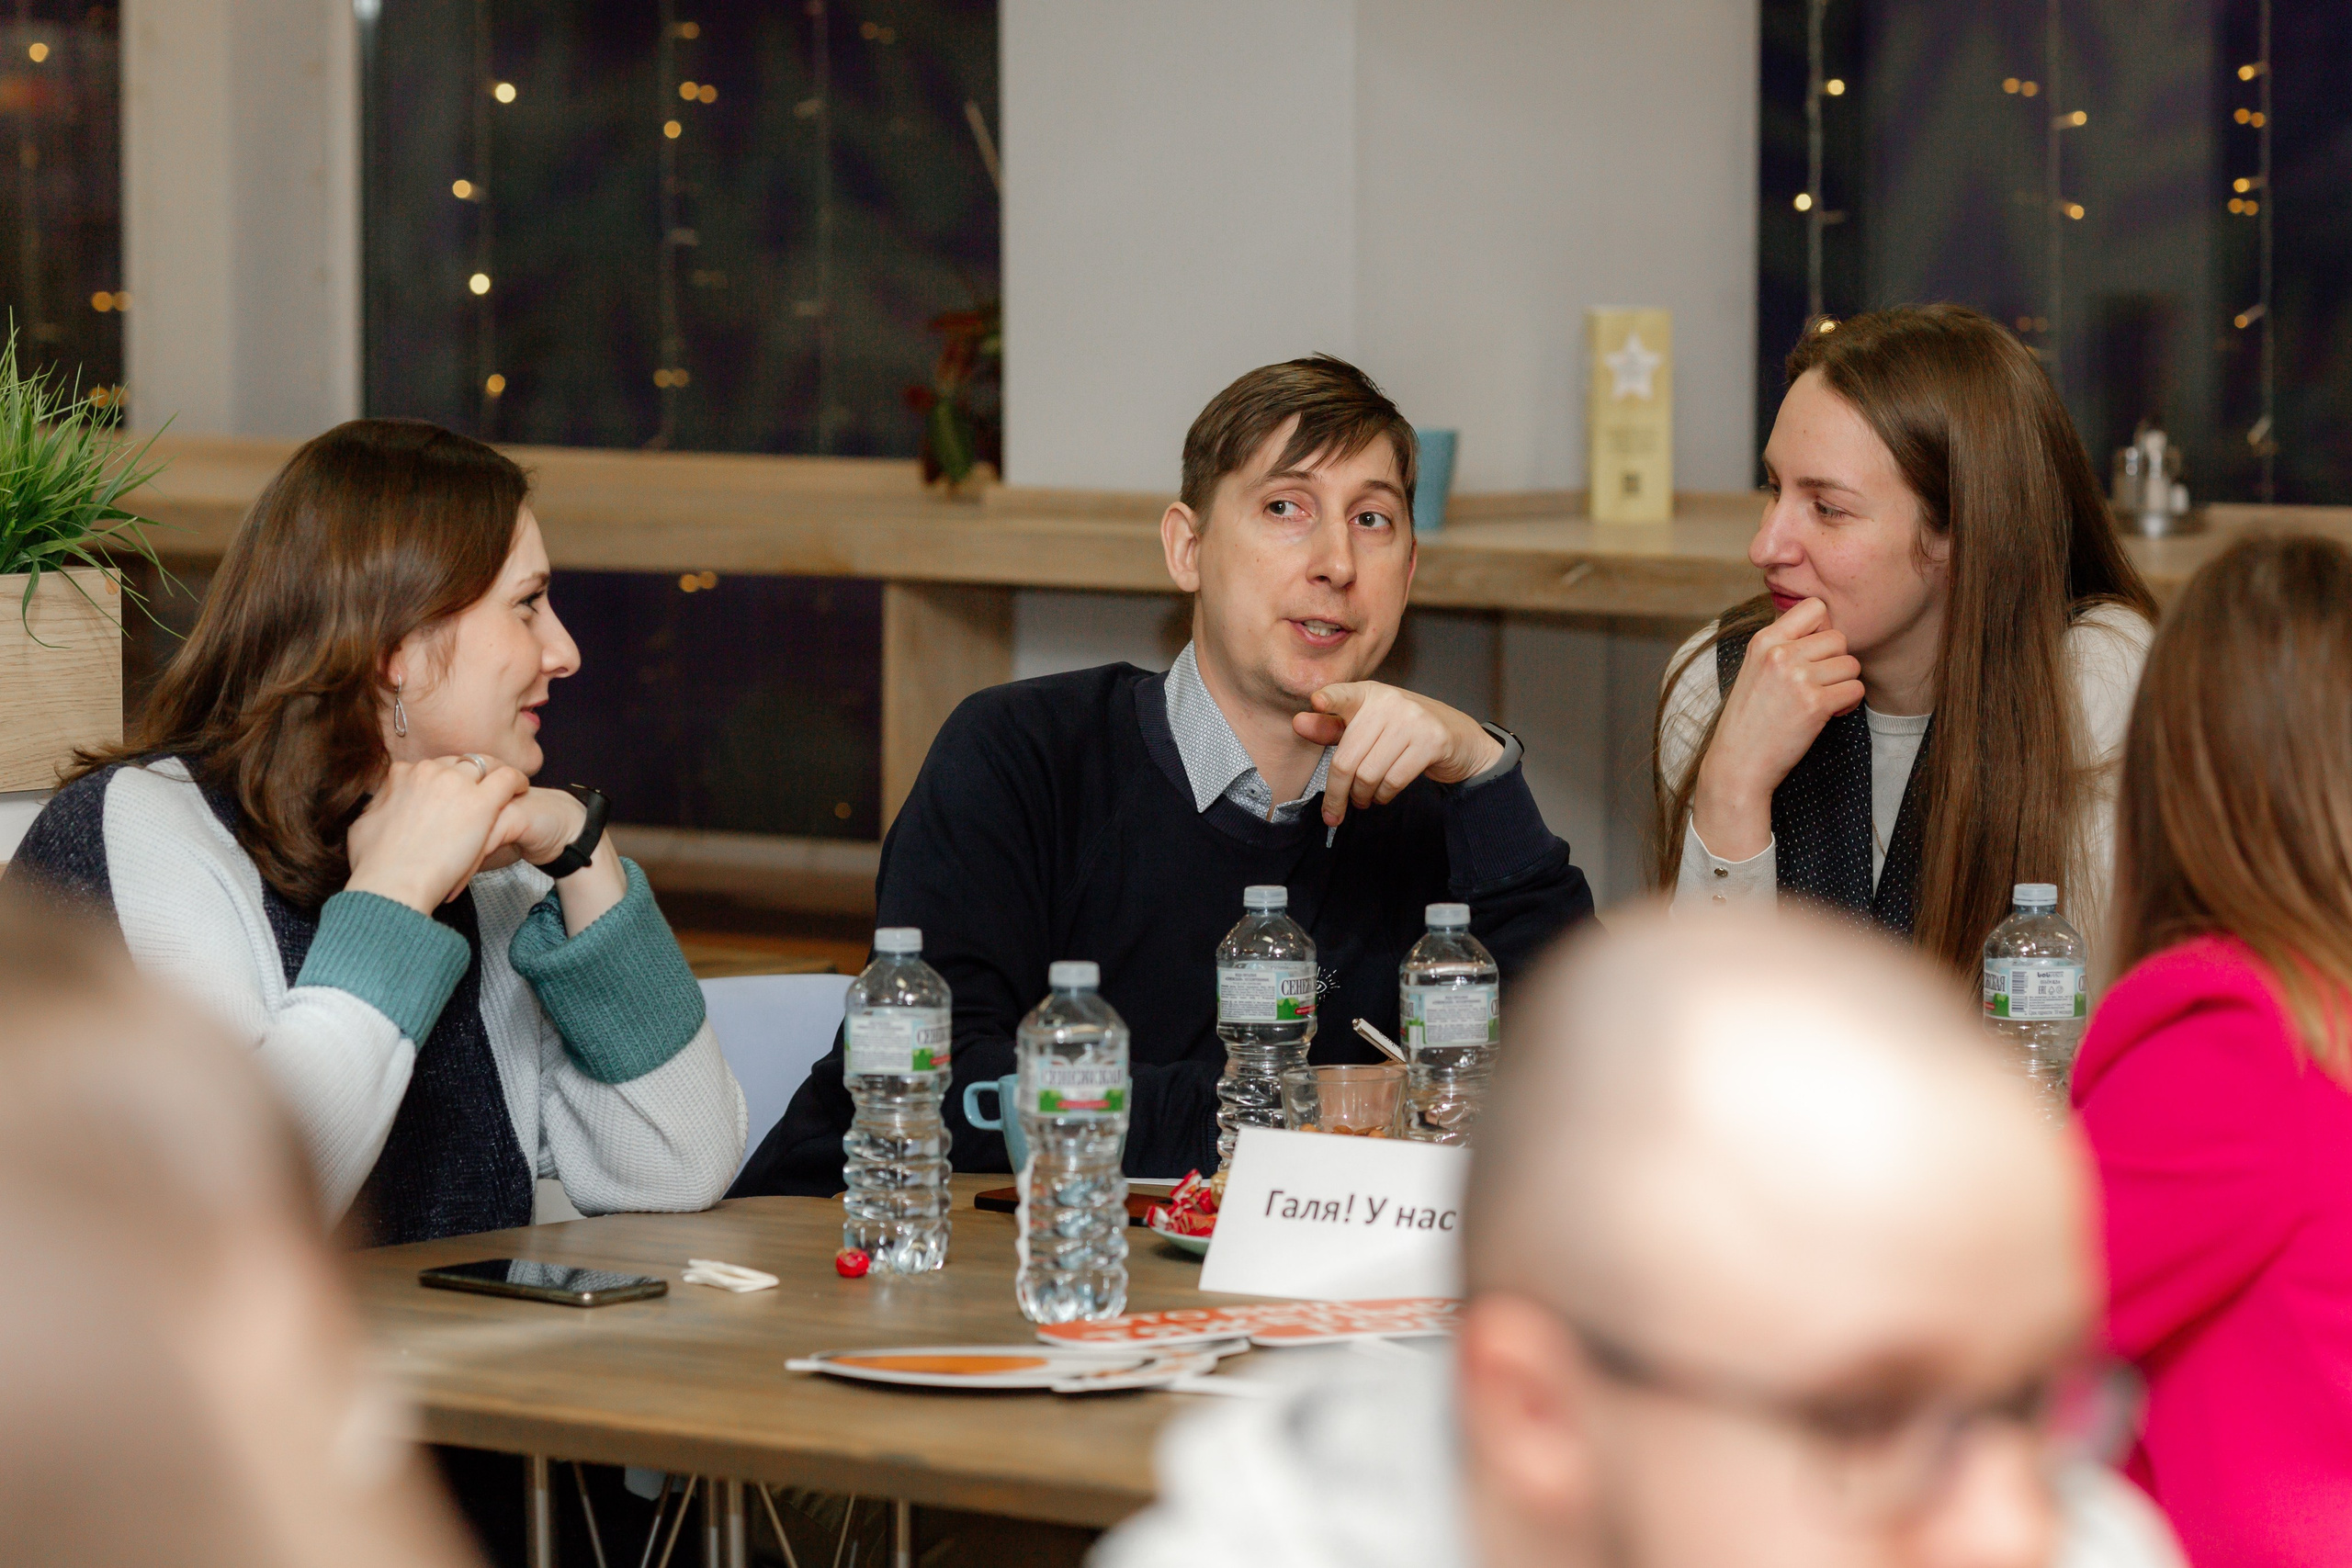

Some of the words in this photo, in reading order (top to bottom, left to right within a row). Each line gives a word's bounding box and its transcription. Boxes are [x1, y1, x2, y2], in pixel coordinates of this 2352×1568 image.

[1265, 1190, 1355, 1223] Галя!
[1364, 1196, 1388, 1224] У
[1395, 1206, 1457, 1231] нас
